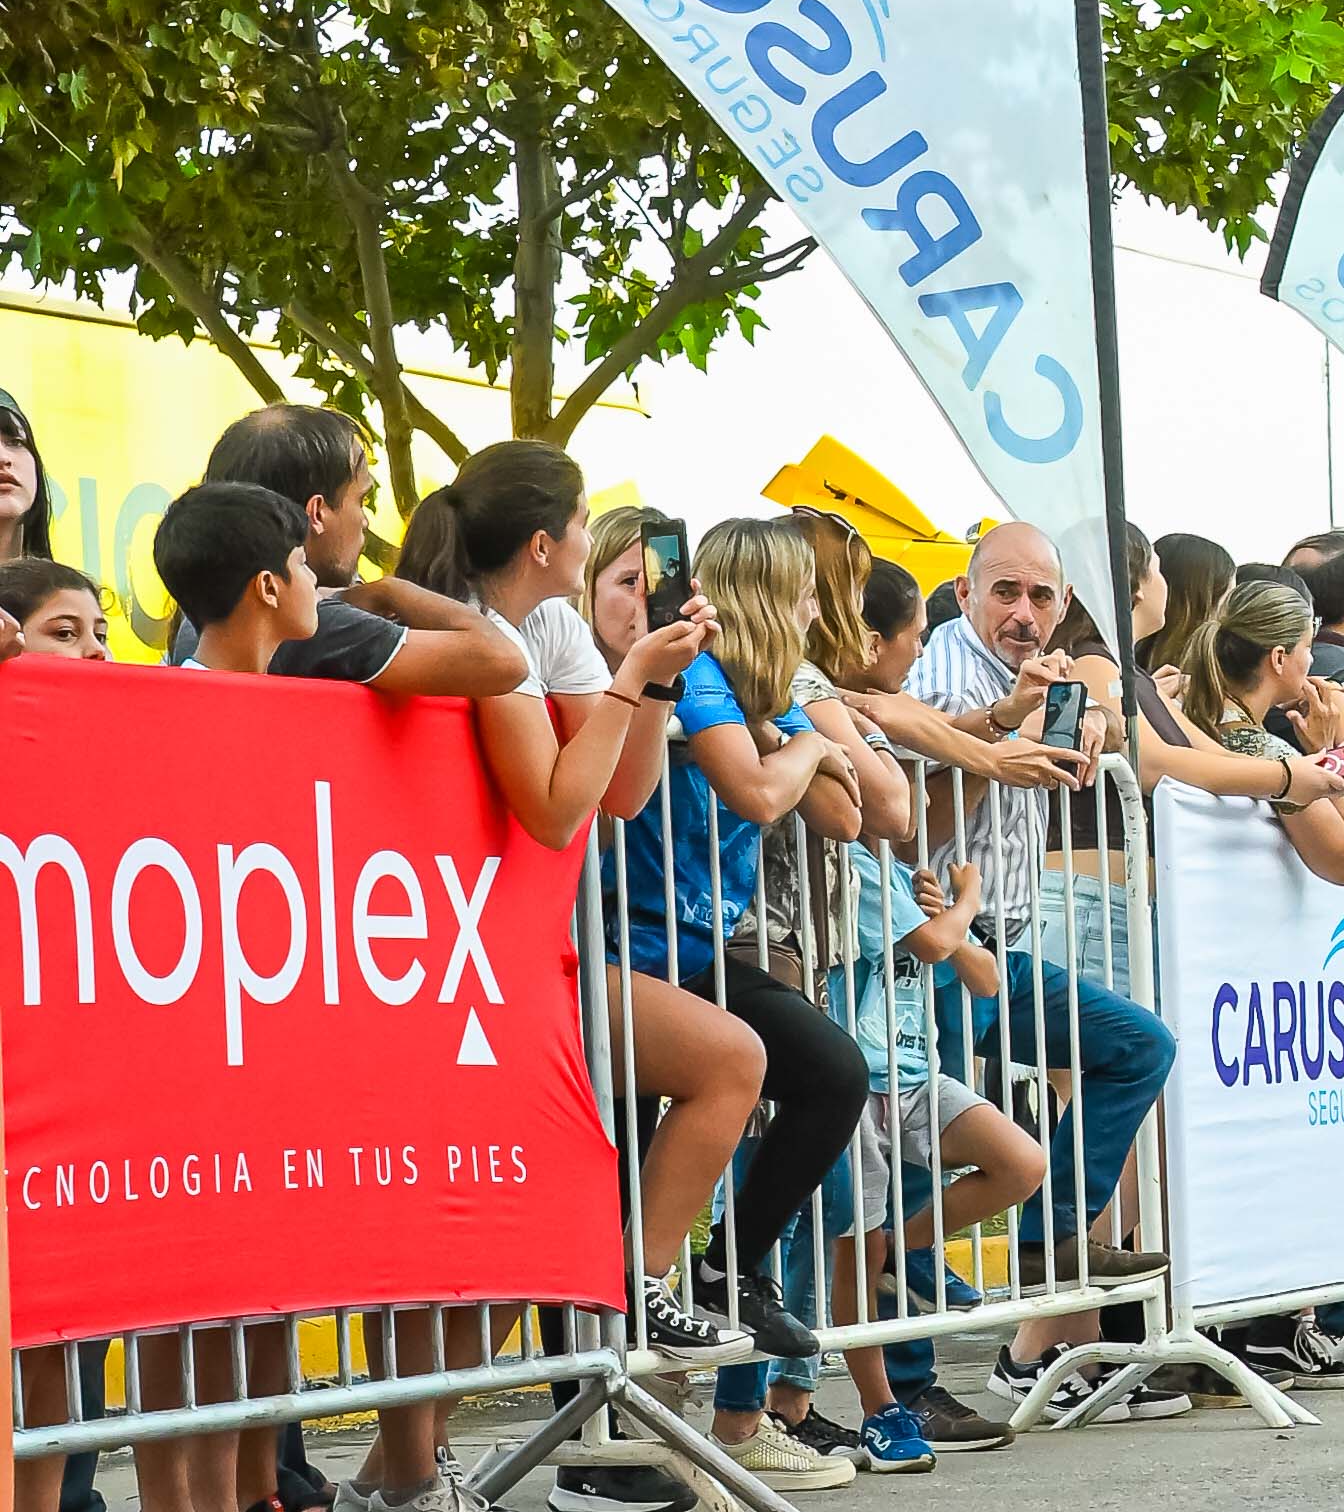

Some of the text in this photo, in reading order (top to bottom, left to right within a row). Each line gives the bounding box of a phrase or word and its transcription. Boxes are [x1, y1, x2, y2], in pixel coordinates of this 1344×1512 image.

[3, 1144, 528, 1210] CNOLOGIA EN TUS PIES
